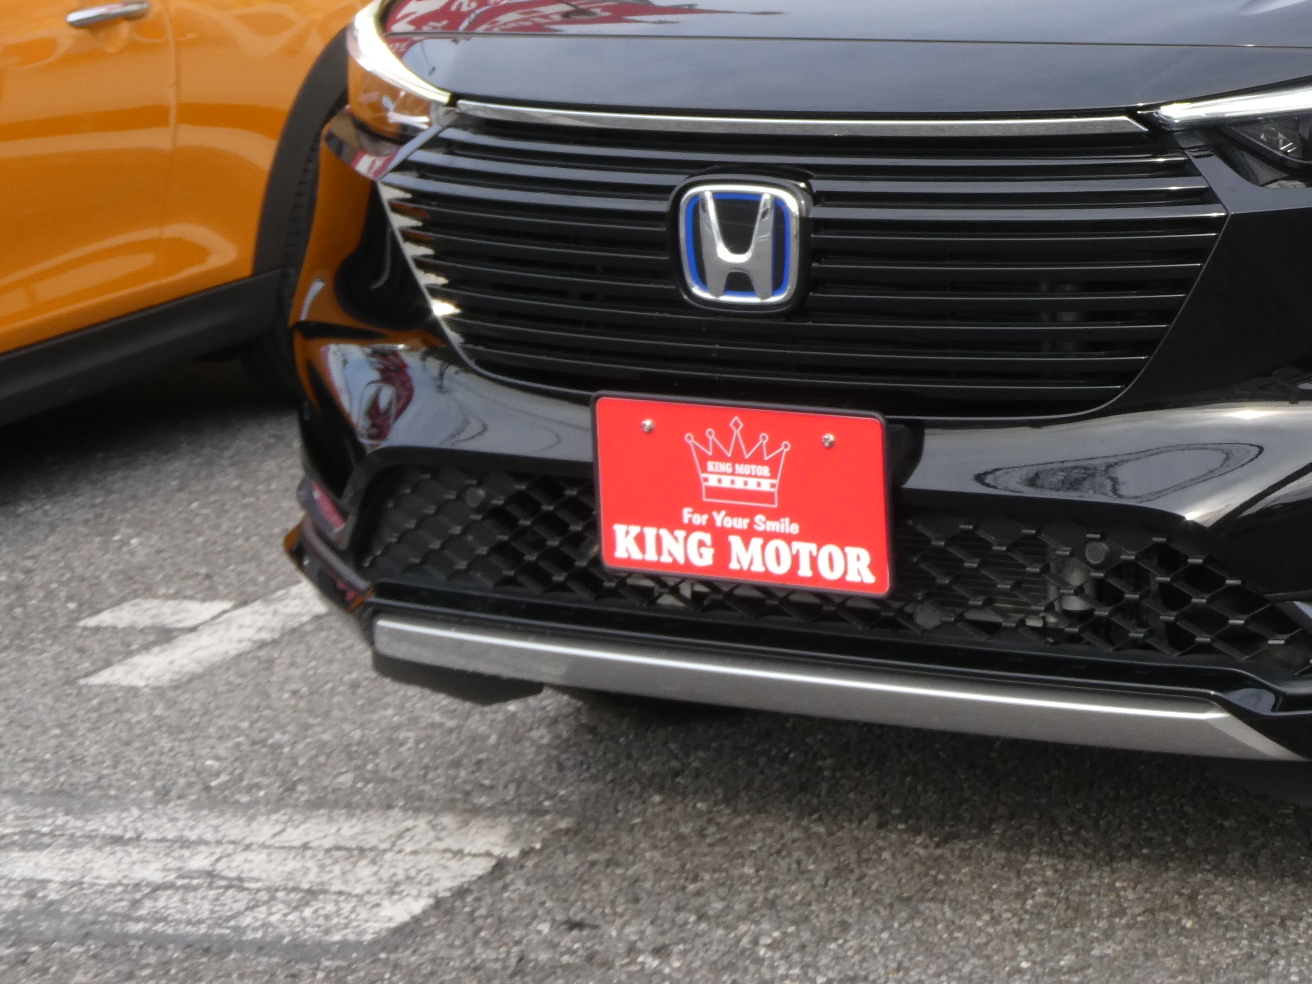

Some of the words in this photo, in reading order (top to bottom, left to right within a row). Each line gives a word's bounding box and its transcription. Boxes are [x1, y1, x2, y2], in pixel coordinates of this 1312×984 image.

[707, 460, 733, 474] KING
[735, 463, 771, 477] MOTOR
[682, 507, 709, 527] For
[711, 510, 750, 531] Your
[753, 514, 800, 535] Smile
[613, 523, 715, 567] KING
[727, 535, 876, 584] MOTOR
